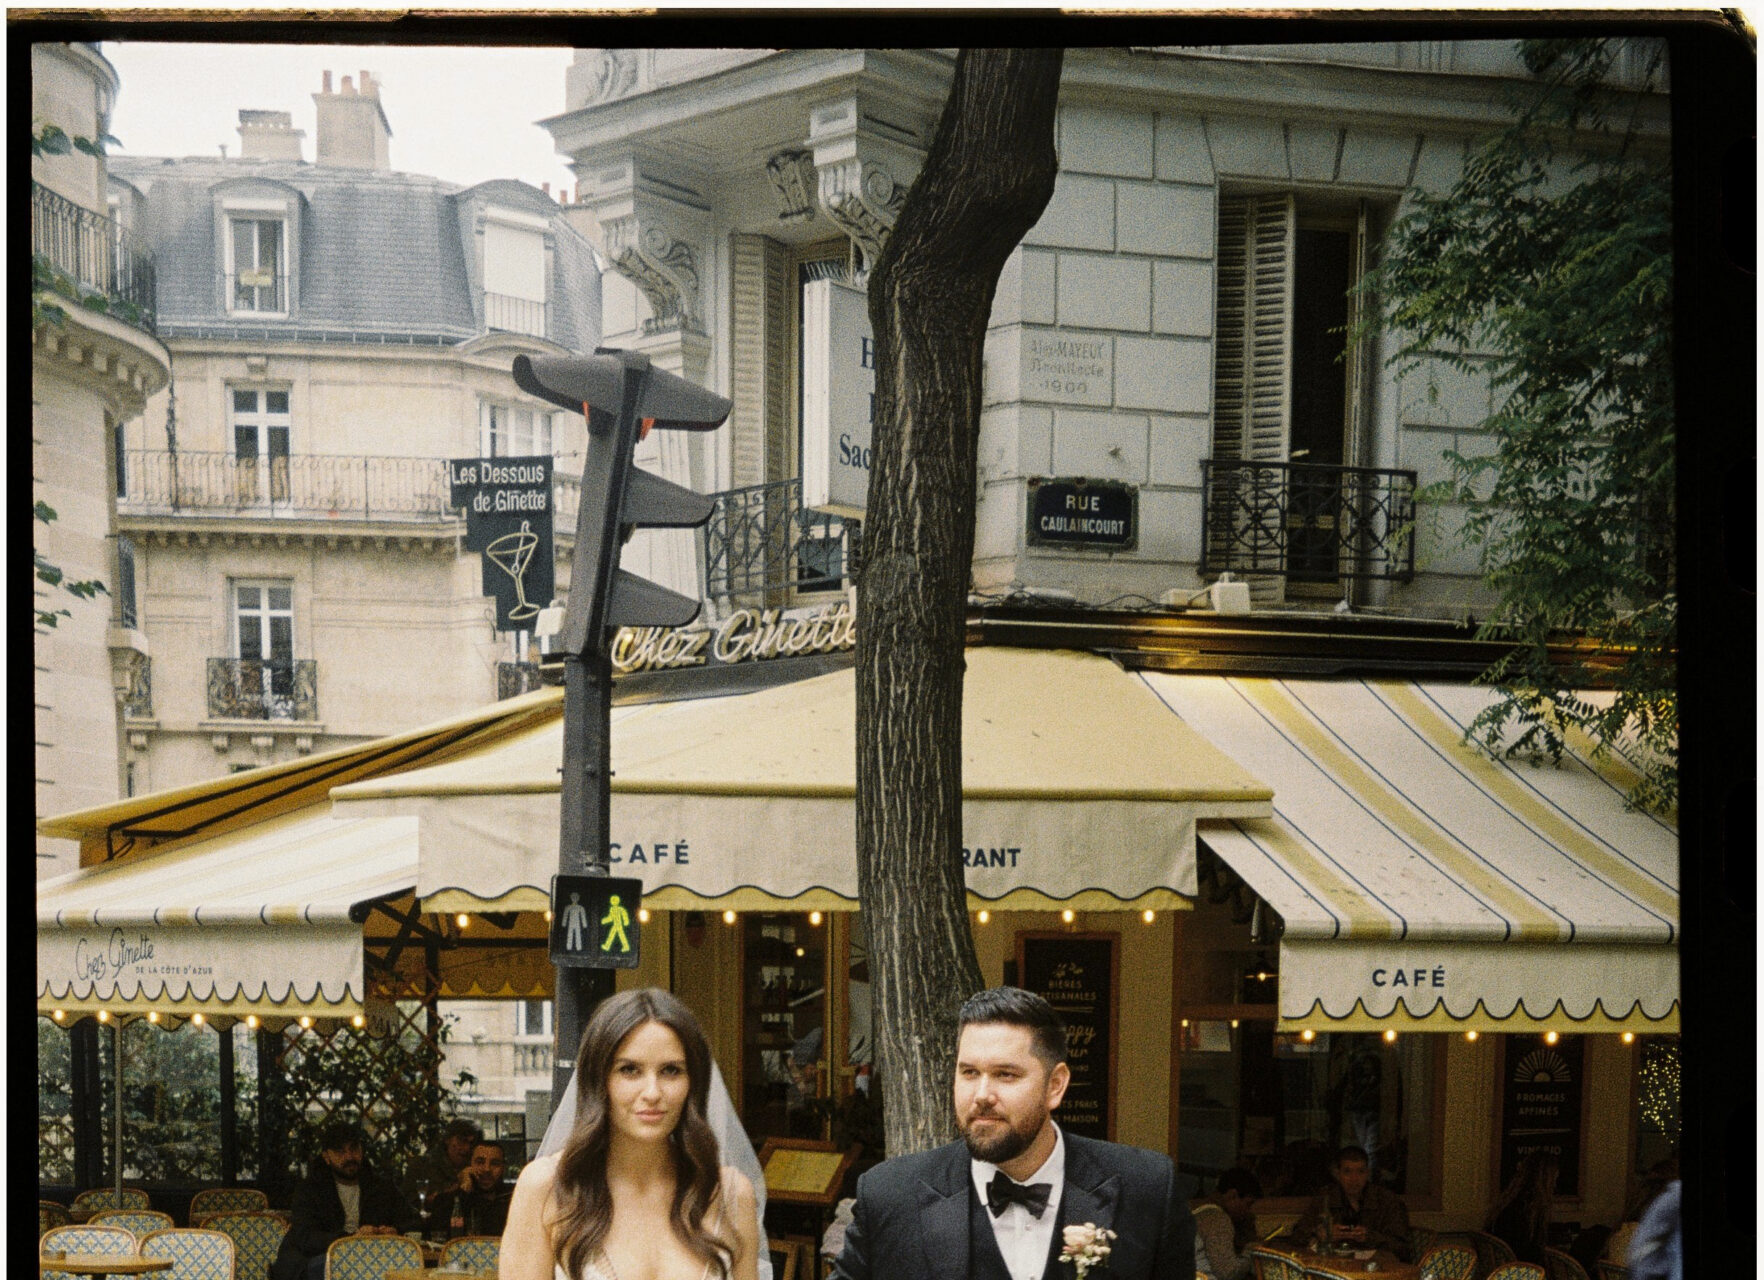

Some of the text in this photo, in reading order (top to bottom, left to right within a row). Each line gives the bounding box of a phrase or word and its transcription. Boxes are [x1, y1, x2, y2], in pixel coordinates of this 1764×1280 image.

[451, 461, 545, 485] Les Dessous
[473, 489, 546, 512] de Ginette
[1065, 494, 1100, 512] RUE
[1040, 515, 1125, 535] CAULAINCOURT
[611, 627, 707, 668] Chez
[609, 839, 689, 865] CAFÉ
[75, 926, 155, 981] Chez Ginette
[135, 966, 145, 974] DE
[148, 966, 158, 974] LA
[183, 965, 213, 975] D'AZUR
[1372, 964, 1445, 987] CAFÉ
[1516, 1092, 1566, 1103] FROMAGES
